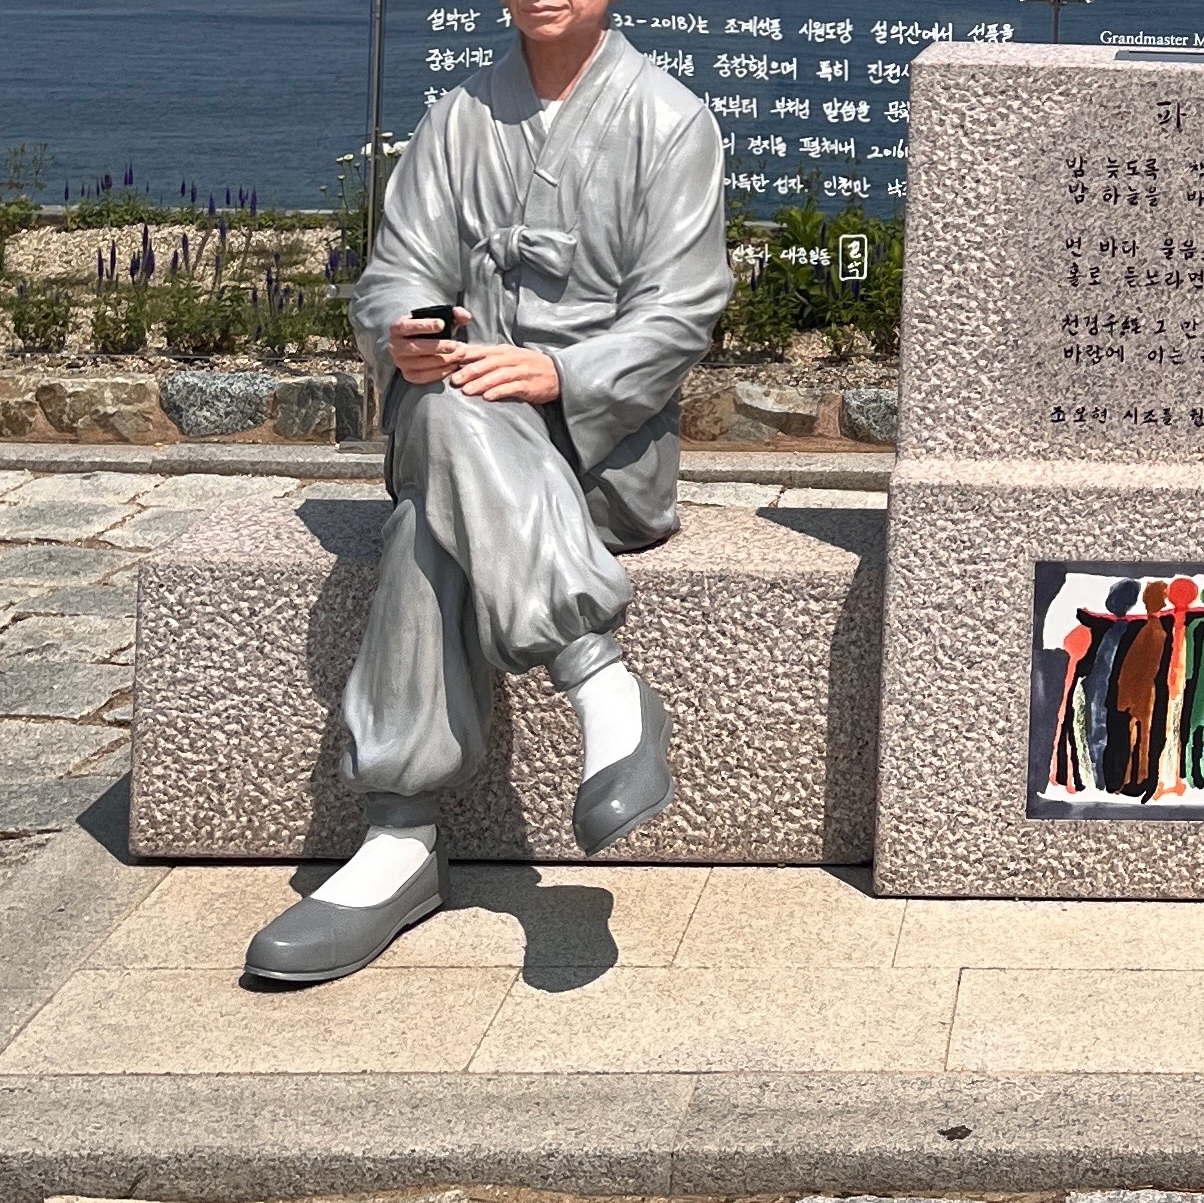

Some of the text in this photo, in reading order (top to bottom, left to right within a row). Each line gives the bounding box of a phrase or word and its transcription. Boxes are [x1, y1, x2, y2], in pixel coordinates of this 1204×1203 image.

[427, 7, 481, 32] 설악당
[1100, 30, 1188, 46] Grandmaster
[816, 59, 848, 82] 특히
[770, 96, 810, 119] 부처님
[823, 97, 870, 122] 말씀을
[866, 139, 908, 159] 2016
[1066, 156, 1087, 178] 밤
[1106, 158, 1160, 180] 늦도록
[1068, 182, 1088, 204] 밤
[1103, 186, 1160, 207] 하늘을
[1066, 237, 1082, 257] 먼
[1100, 236, 1139, 258] 바다
[1067, 262, 1101, 287] 홀로
[1153, 319, 1167, 335] 그
[1063, 345, 1125, 365] 바람에
[1148, 346, 1184, 366] 이는
